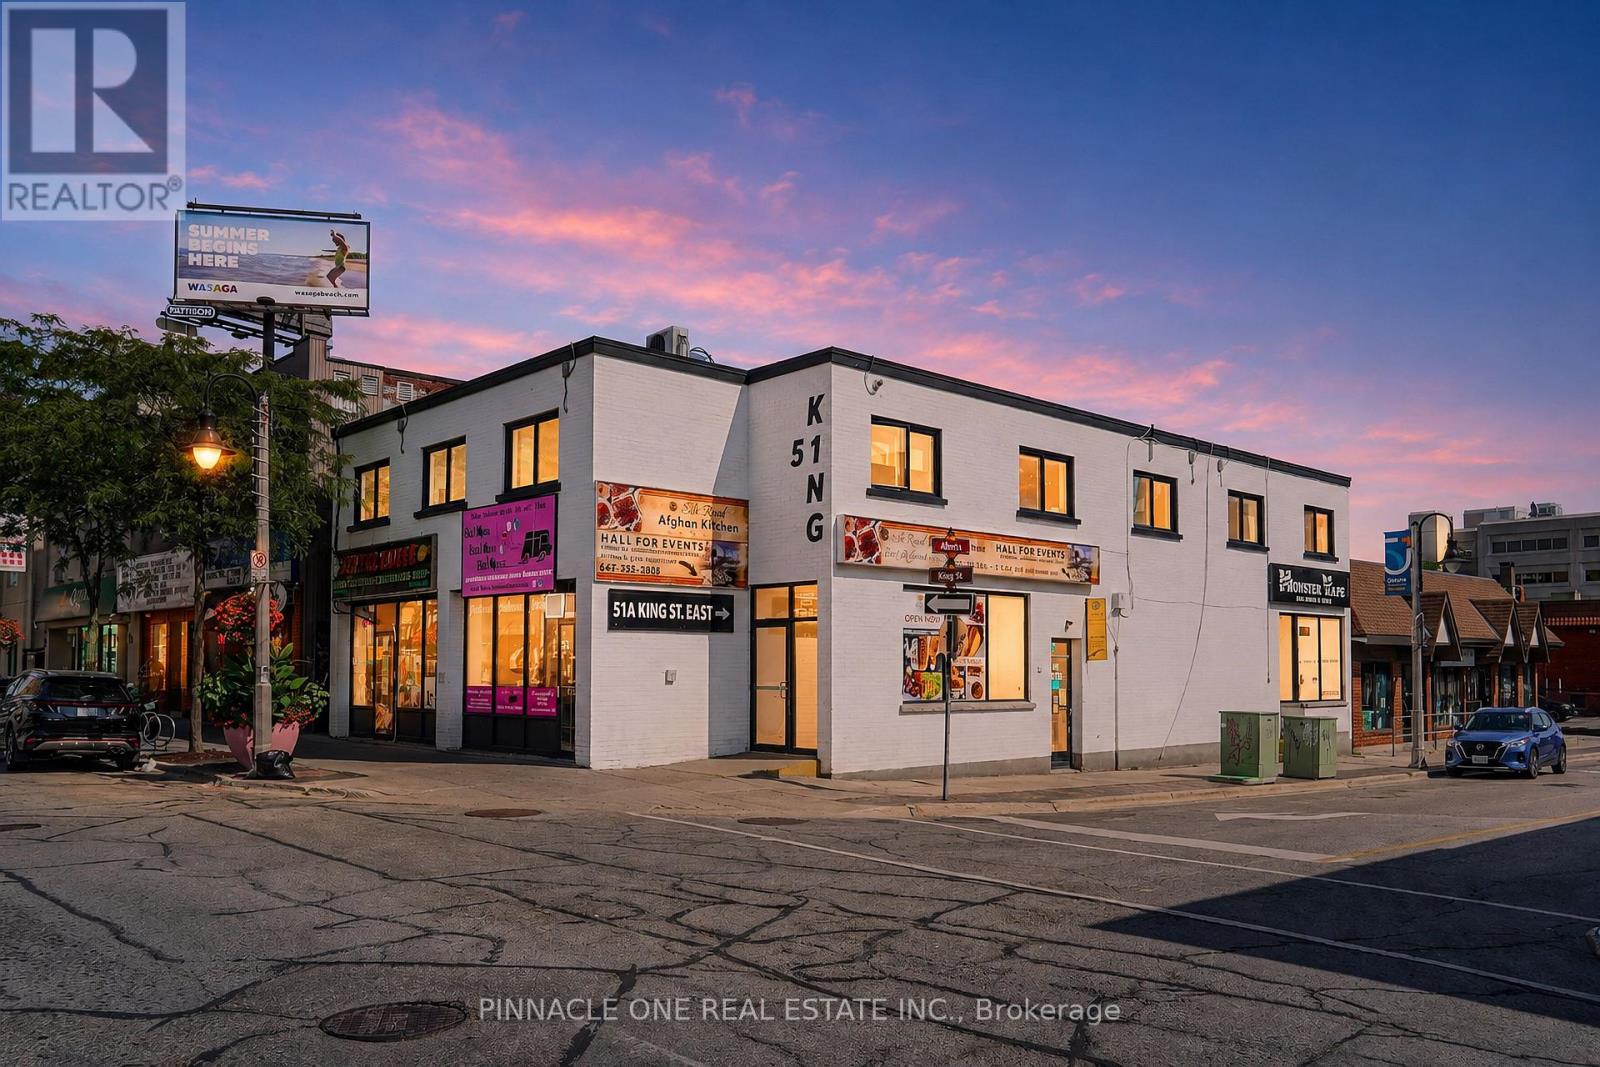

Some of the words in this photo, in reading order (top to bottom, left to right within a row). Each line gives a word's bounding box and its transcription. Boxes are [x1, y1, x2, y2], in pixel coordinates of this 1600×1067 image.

[188, 224, 270, 241] SUMMER
[188, 238, 259, 256] BEGINS
[188, 252, 239, 268] HERE
[187, 282, 238, 293] WASAGA
[658, 514, 698, 529] Afghan
[701, 519, 739, 533] Kitchen
[601, 533, 632, 546] HALL
[636, 537, 658, 548] FOR
[663, 540, 704, 552] EVENTS
[995, 544, 1017, 555] HALL
[1019, 547, 1035, 557] FOR
[1036, 548, 1065, 560] EVENTS
[613, 601, 636, 618] 51A
[638, 602, 667, 619] KING
[669, 603, 685, 620] ST.
[686, 604, 713, 621] EAST
[904, 614, 923, 623] OPEN
